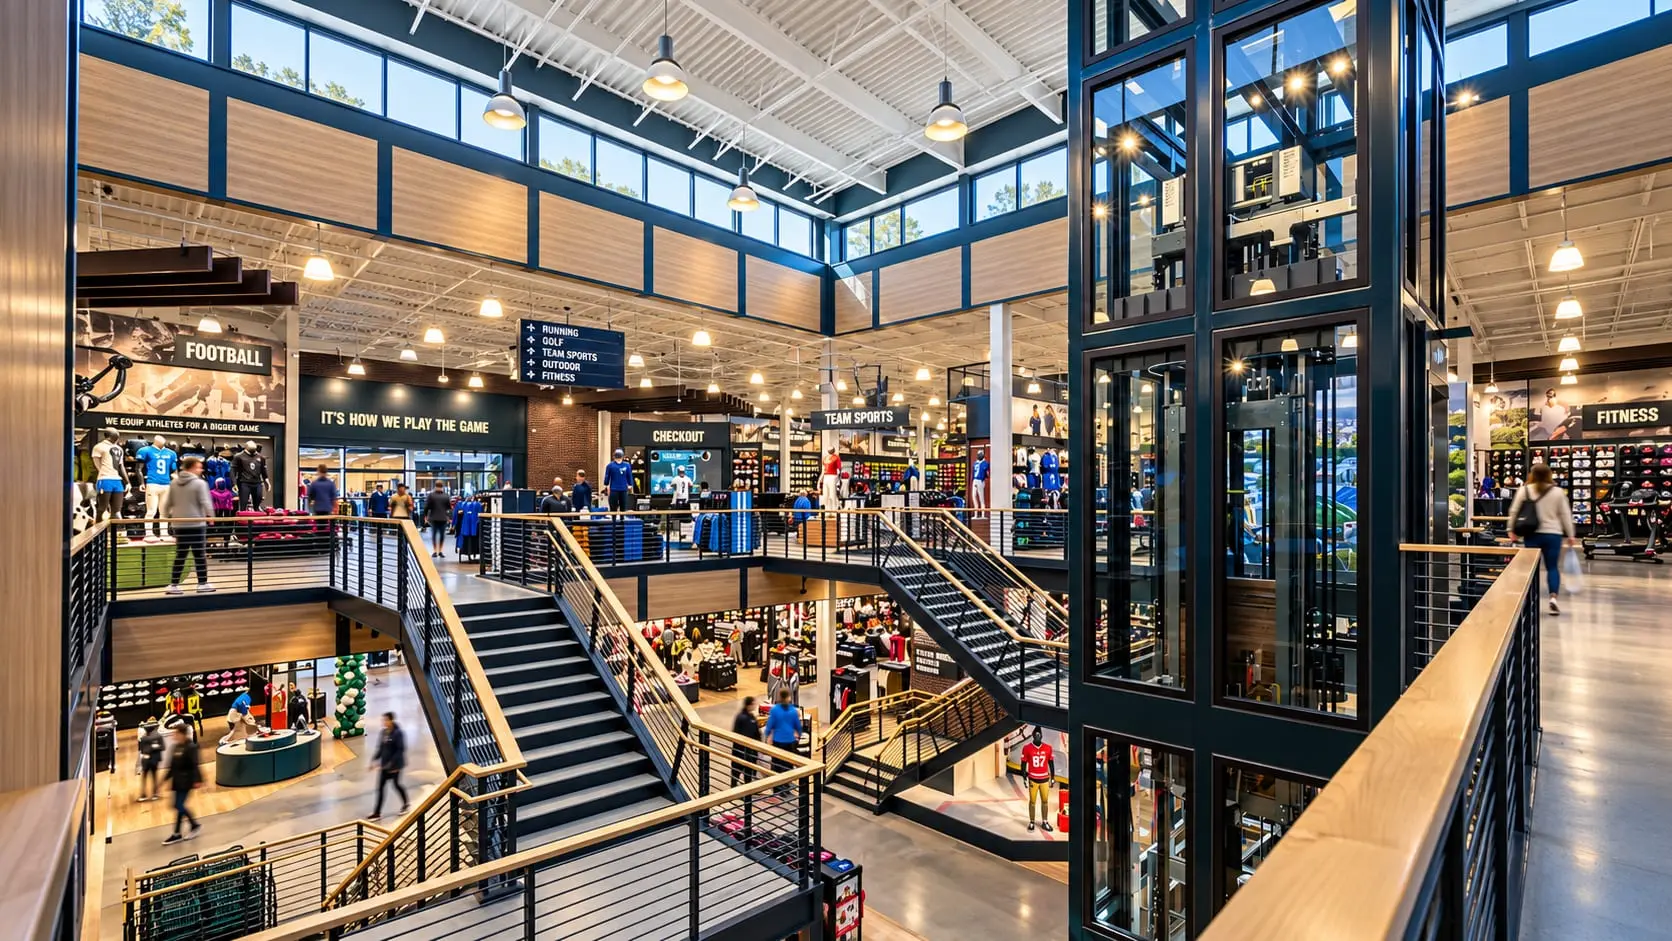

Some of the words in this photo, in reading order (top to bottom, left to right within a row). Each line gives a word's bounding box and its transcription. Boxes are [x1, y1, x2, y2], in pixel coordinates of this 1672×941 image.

[542, 325, 579, 337] RUNNING
[542, 336, 564, 347] GOLF
[185, 342, 264, 367] FOOTBALL
[542, 348, 565, 358] TEAM
[566, 351, 598, 362] SPORTS
[321, 410, 345, 425] IT'S
[349, 413, 378, 428] HOW
[381, 415, 400, 428] WE
[404, 416, 432, 430] PLAY
[435, 418, 456, 431] THE
[459, 420, 489, 434] GAME
[825, 412, 852, 425] TEAM
[853, 410, 894, 424] SPORTS
[1596, 407, 1659, 425] FITNESS
[105, 417, 119, 426] WE
[146, 420, 184, 429] ATHLETES
[186, 421, 200, 430] FOR
[202, 422, 208, 430] A
[652, 430, 705, 442] CHECKOUT
[156, 459, 166, 475] 9
[1032, 755, 1046, 768] 87
